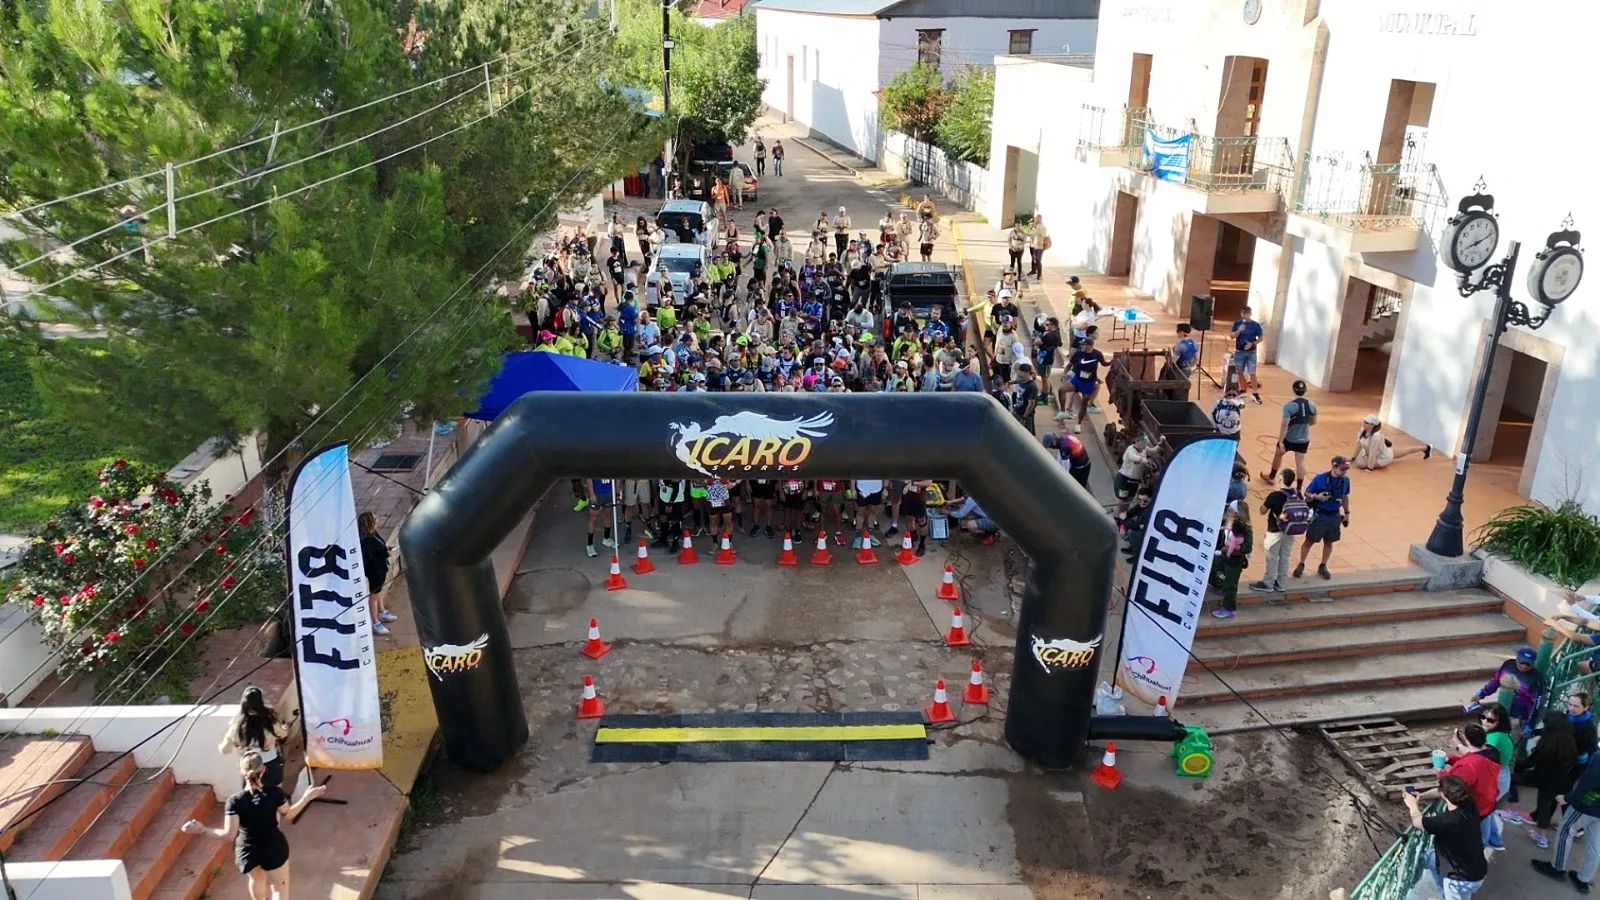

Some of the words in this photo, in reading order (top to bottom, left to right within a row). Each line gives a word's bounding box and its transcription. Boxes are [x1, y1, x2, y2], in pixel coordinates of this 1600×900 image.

[1378, 12, 1477, 36] MUNICIPAL
[687, 436, 811, 466] ICARO
[350, 547, 371, 666] CHIHUAHUA
[1183, 527, 1214, 630] CHIHUAHUA
